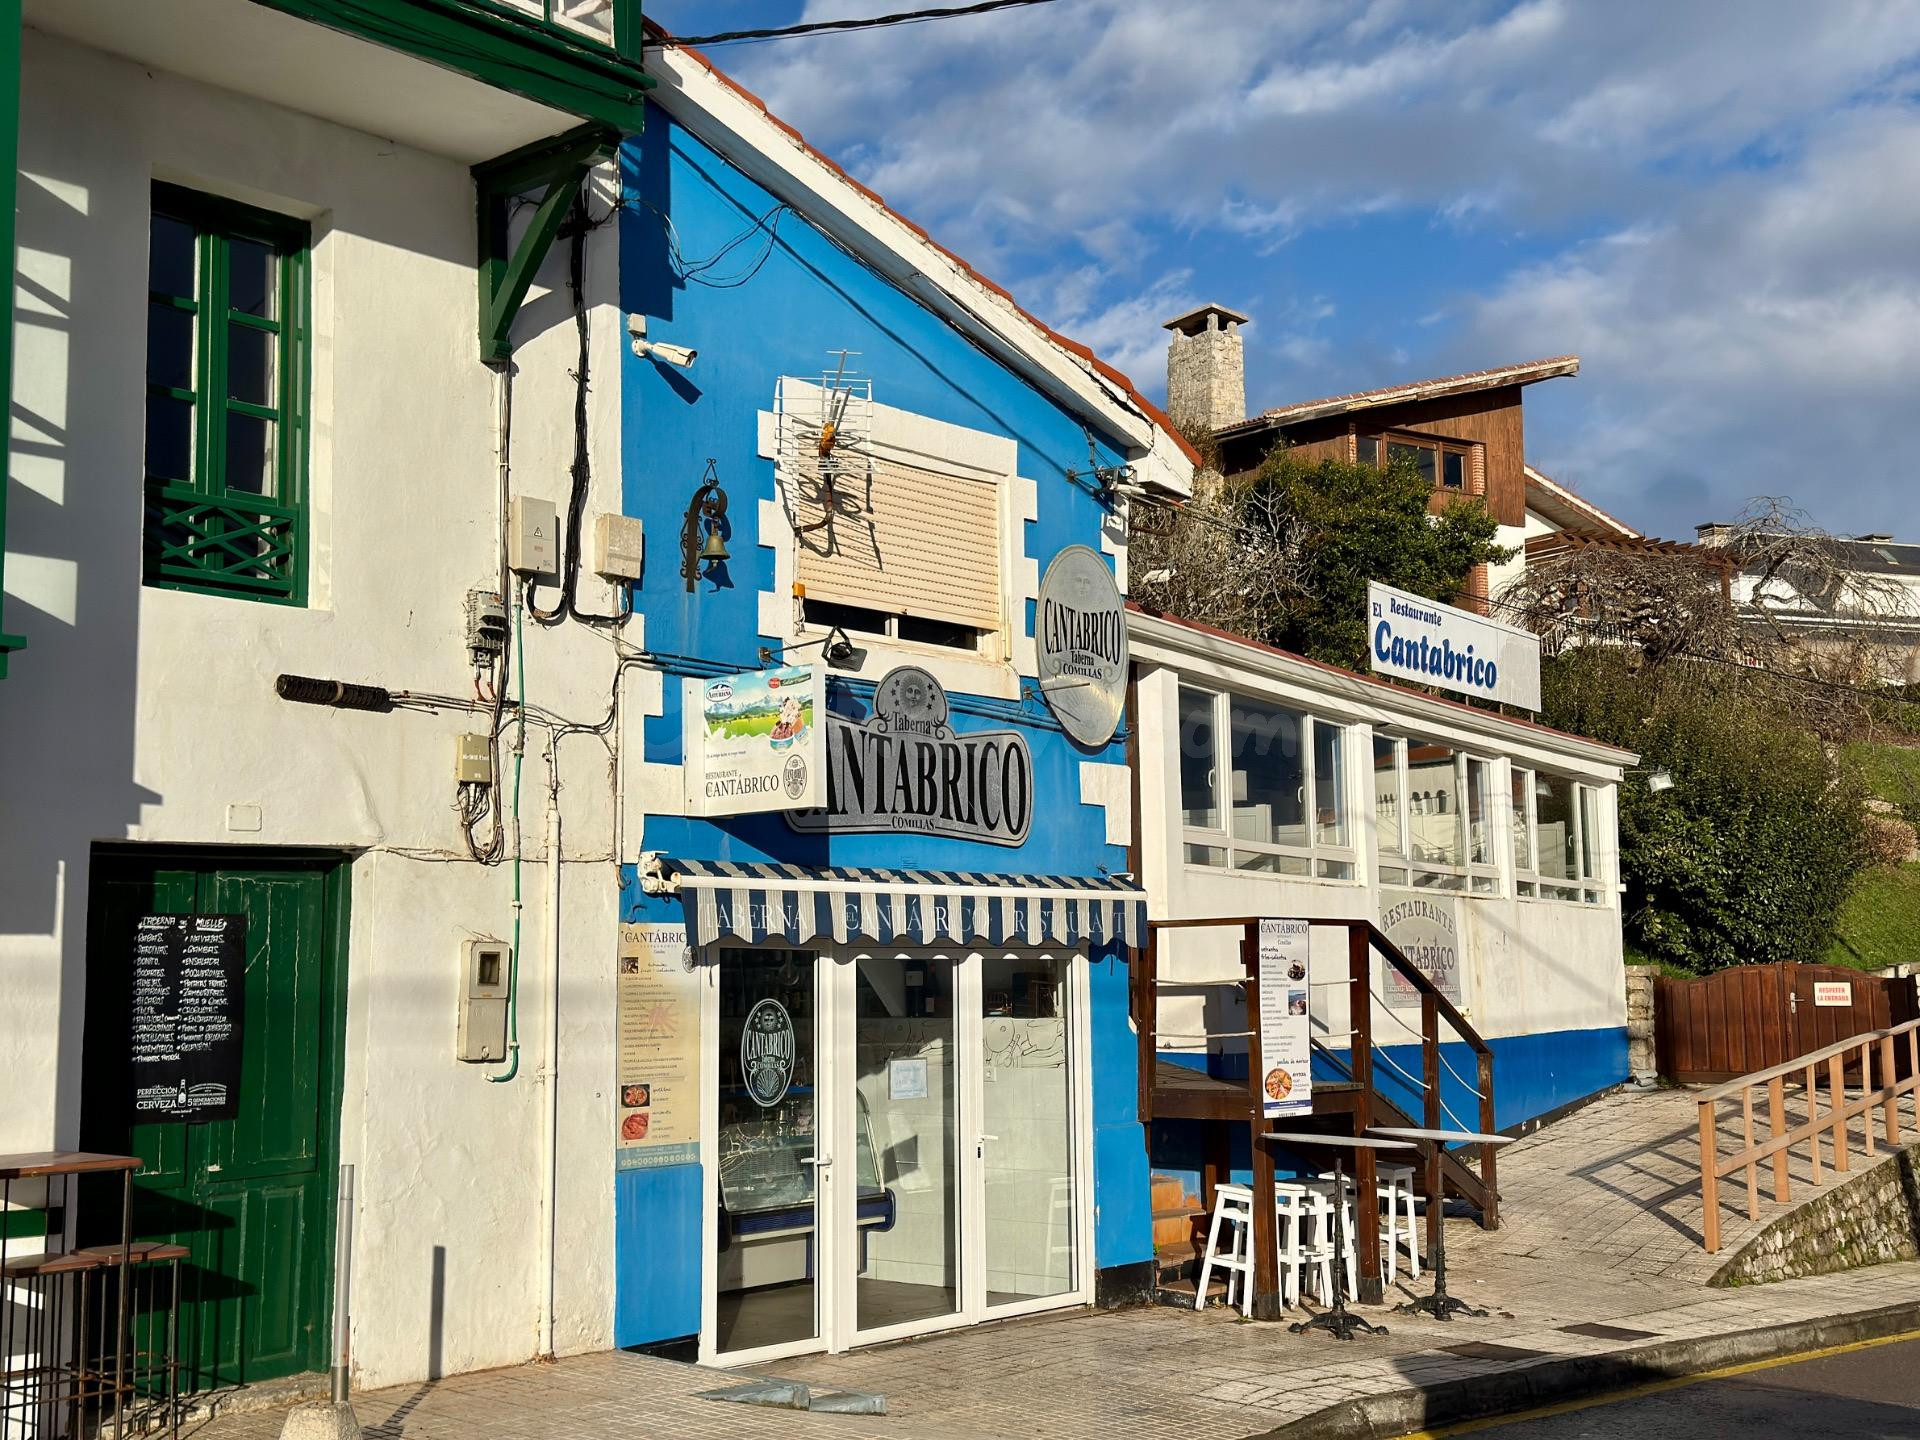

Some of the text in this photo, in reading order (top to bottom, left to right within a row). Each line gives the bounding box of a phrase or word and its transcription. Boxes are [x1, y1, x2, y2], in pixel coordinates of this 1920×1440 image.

[1372, 597, 1442, 627] El Restaurante
[1044, 598, 1121, 666] CANTABRICO
[1071, 651, 1094, 666] Taberna
[1375, 620, 1497, 689] Cantabrico
[1063, 663, 1102, 680] COMILLAS
[893, 711, 931, 735] Taberna
[706, 769, 738, 780] RESTAURANTE
[795, 723, 1028, 836] ANTABRICO
[705, 773, 779, 798] CANTÁBRICO
[891, 815, 936, 832] COMILLAS
[142, 916, 176, 926] TABERNA
[196, 918, 224, 929] MUELLE
[701, 903, 808, 930] TABERNA
[1382, 900, 1454, 934] RESTAURANTE
[625, 929, 687, 943] CANTÁBRIC
[746, 1029, 791, 1060] CANTABRICO
[137, 1086, 178, 1096] PERFECCIÓN
[136, 1099, 177, 1109] CERVEZA
[187, 1098, 193, 1107] 5
